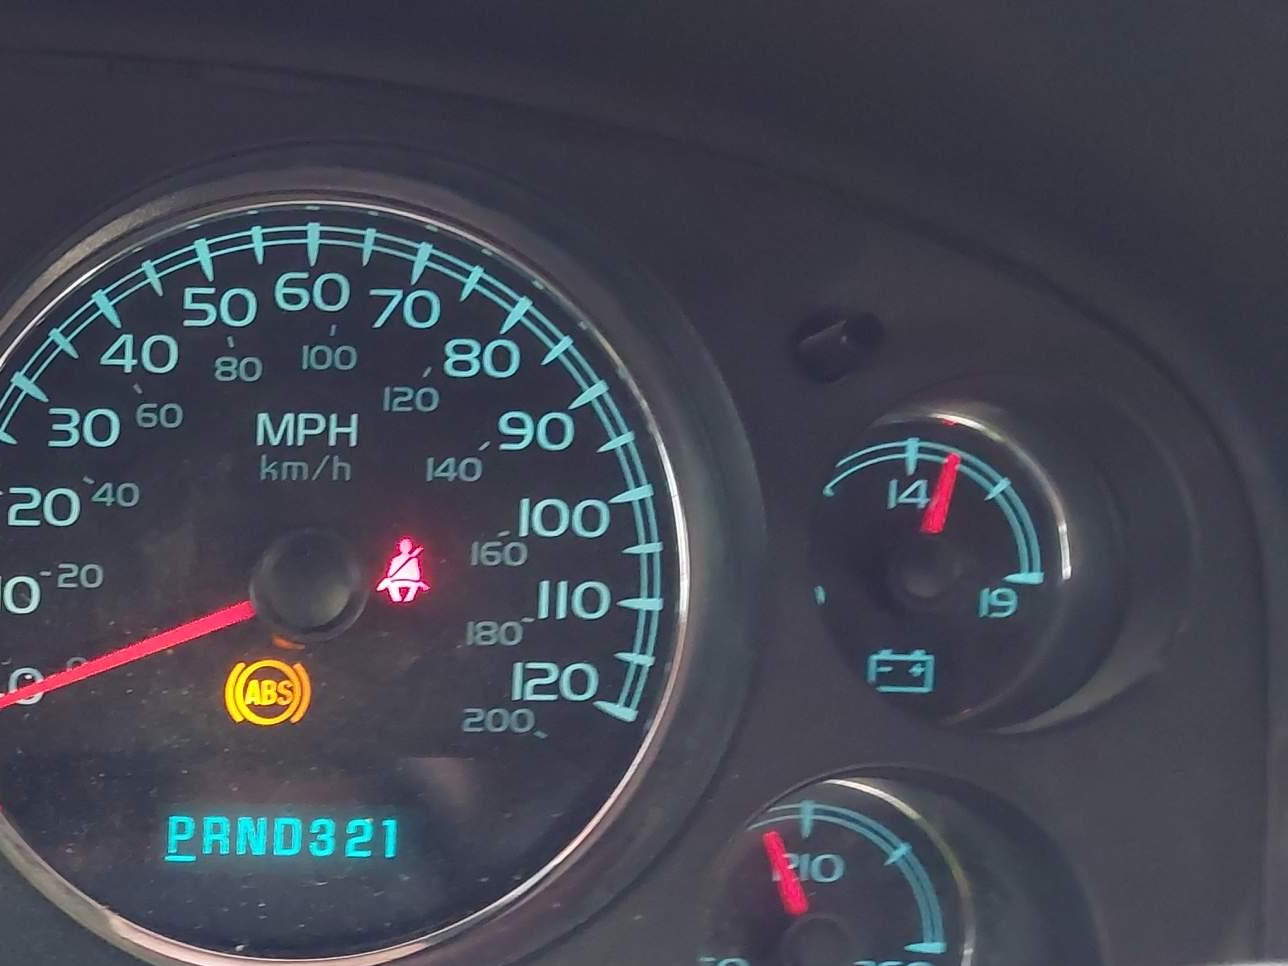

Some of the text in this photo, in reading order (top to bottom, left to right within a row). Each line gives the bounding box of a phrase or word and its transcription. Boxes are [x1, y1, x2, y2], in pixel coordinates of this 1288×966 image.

[182, 287, 258, 327] 50
[274, 271, 351, 312] 60
[369, 288, 441, 329] 70
[99, 333, 179, 374] 40
[214, 356, 263, 382] 80
[301, 344, 358, 370] 100
[443, 338, 521, 379] 80
[382, 386, 440, 412] 120
[48, 407, 121, 448] 30
[135, 403, 184, 429] 60
[255, 412, 359, 447] MPH
[497, 410, 575, 451] 90
[259, 454, 352, 481] km/h
[425, 457, 483, 482] 140
[7, 486, 81, 527] 20
[91, 482, 140, 508] 40
[887, 479, 930, 509] 14
[518, 498, 610, 538] 100
[470, 541, 528, 567] 160
[57, 563, 104, 589] 20
[537, 580, 611, 620] 110
[978, 587, 1018, 619] 19
[466, 621, 524, 646] 180
[245, 679, 294, 706] ABS
[512, 661, 599, 702] 120
[462, 708, 535, 733] 200
